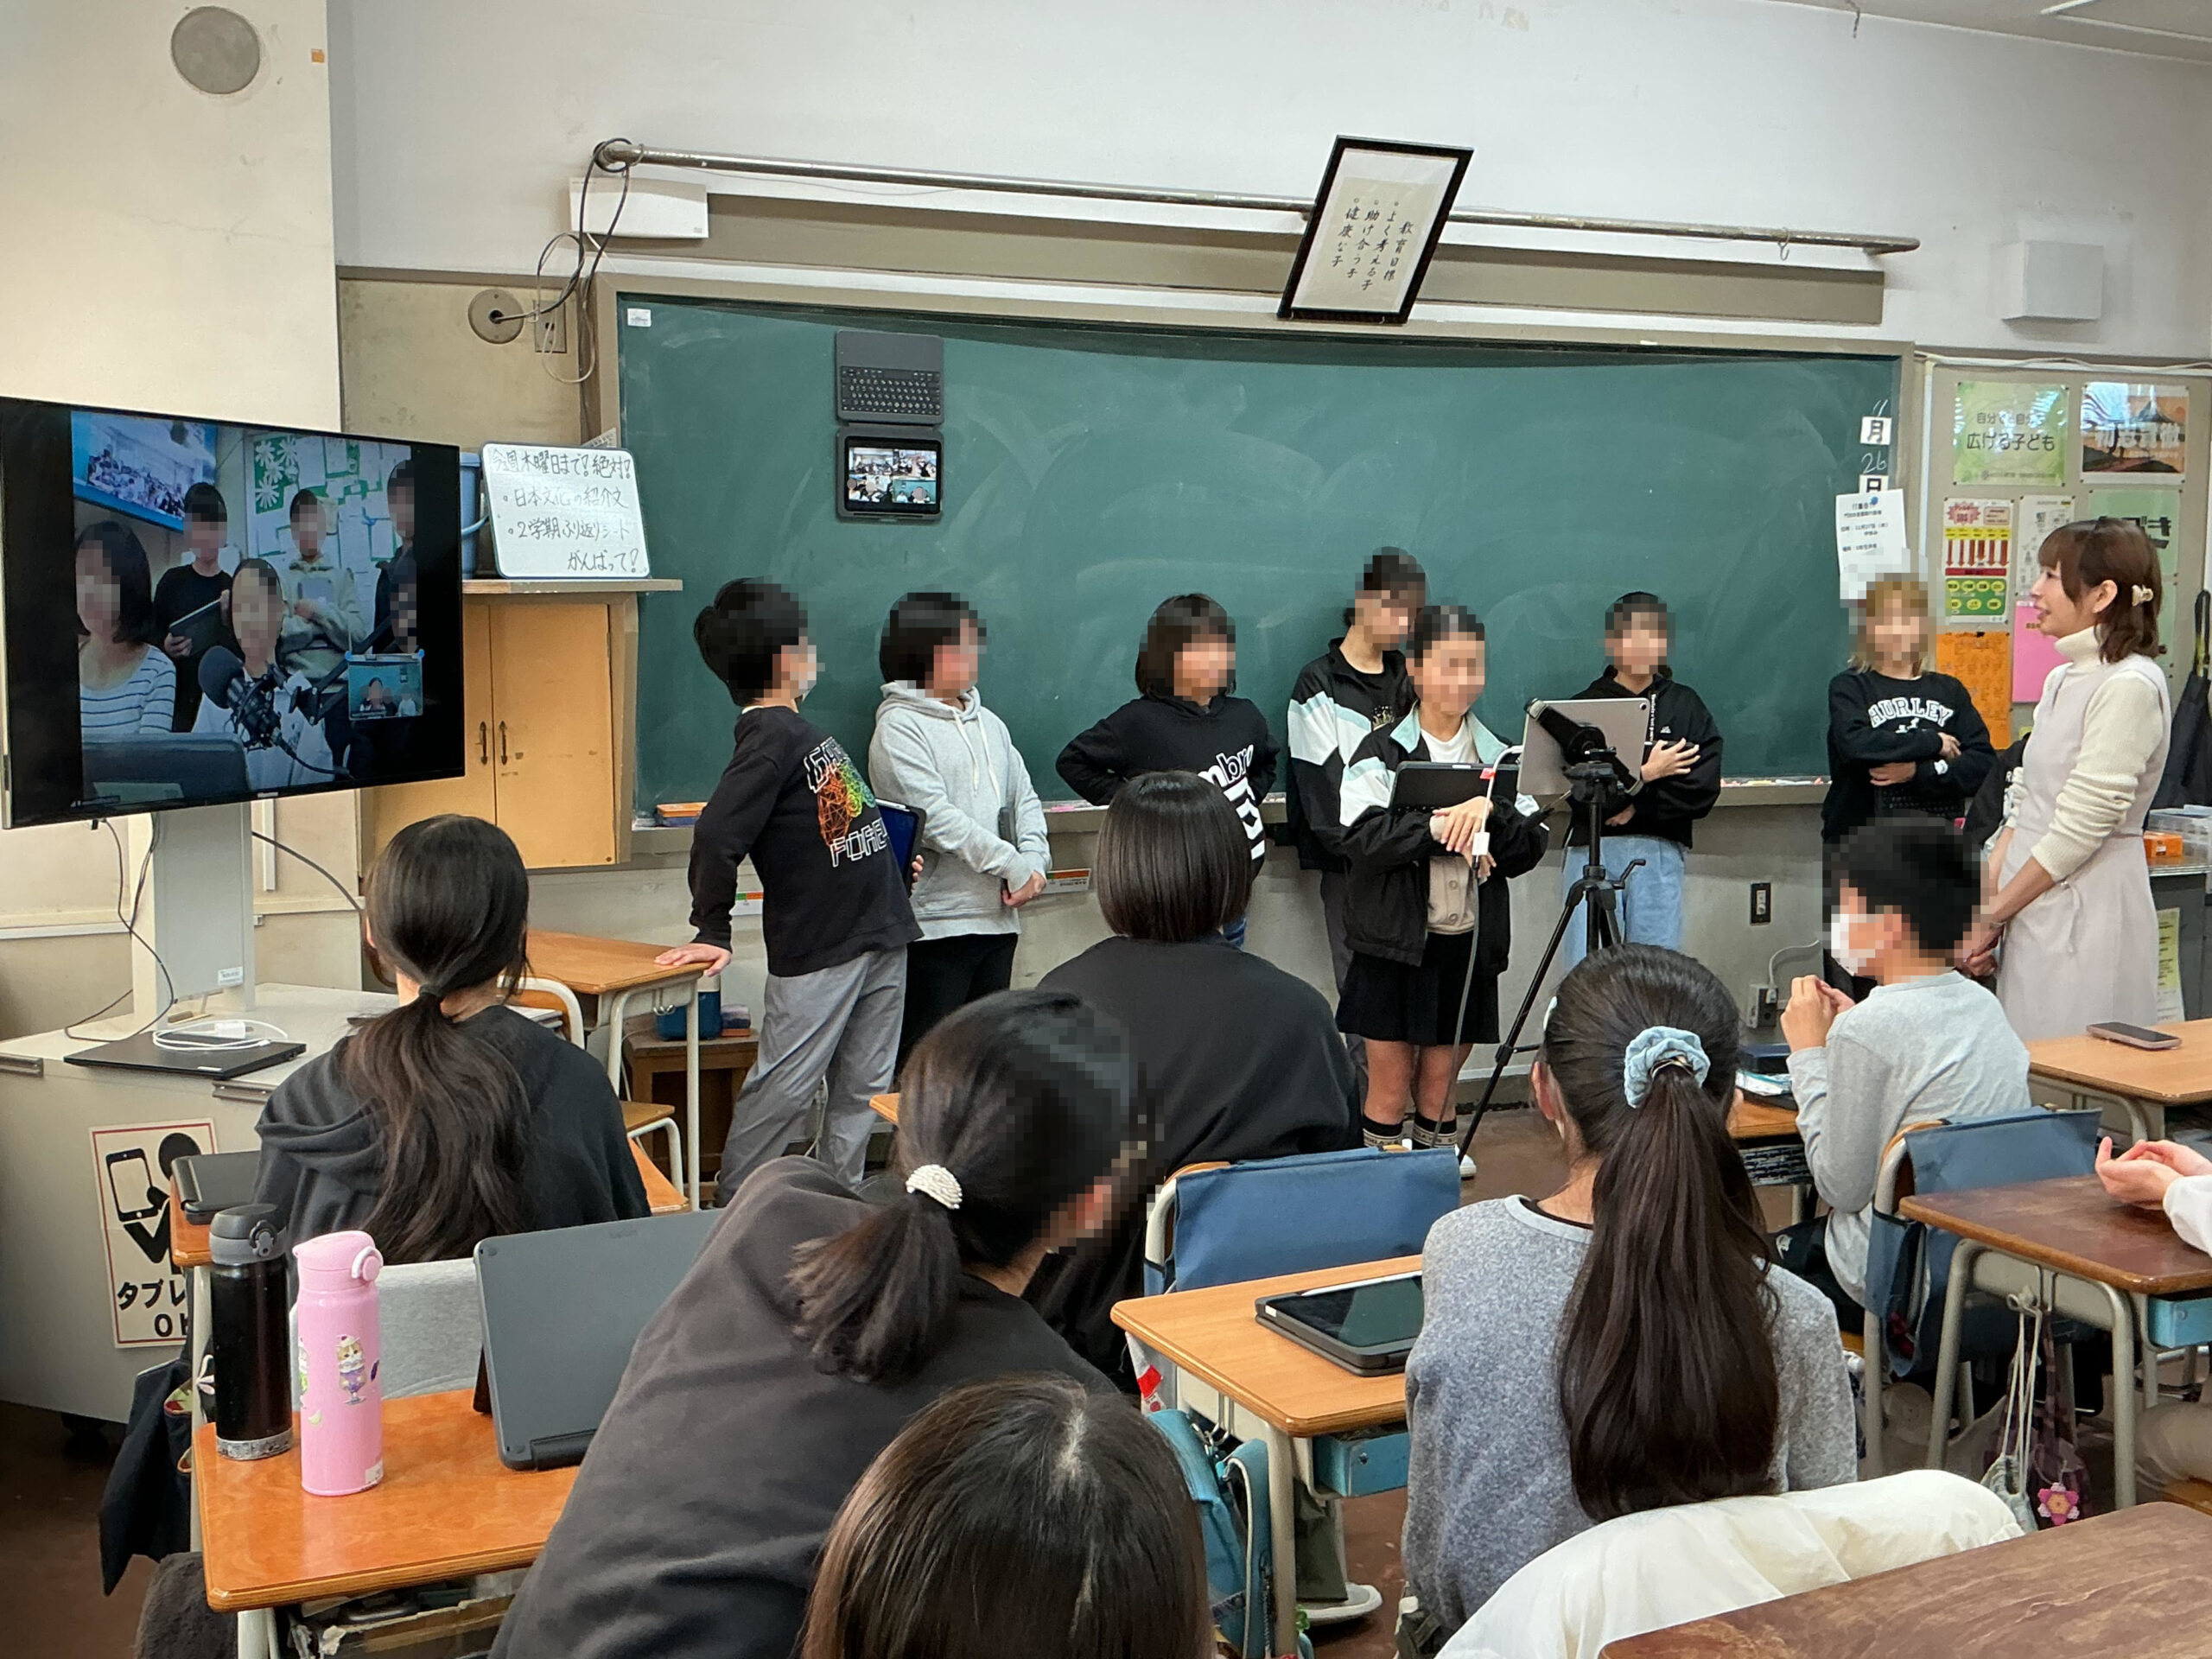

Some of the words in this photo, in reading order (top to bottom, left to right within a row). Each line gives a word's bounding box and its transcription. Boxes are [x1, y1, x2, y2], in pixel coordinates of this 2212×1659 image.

[1867, 696, 1955, 728] HURLEY
[1198, 744, 1254, 787] mbro
[830, 817, 888, 868] FORE
